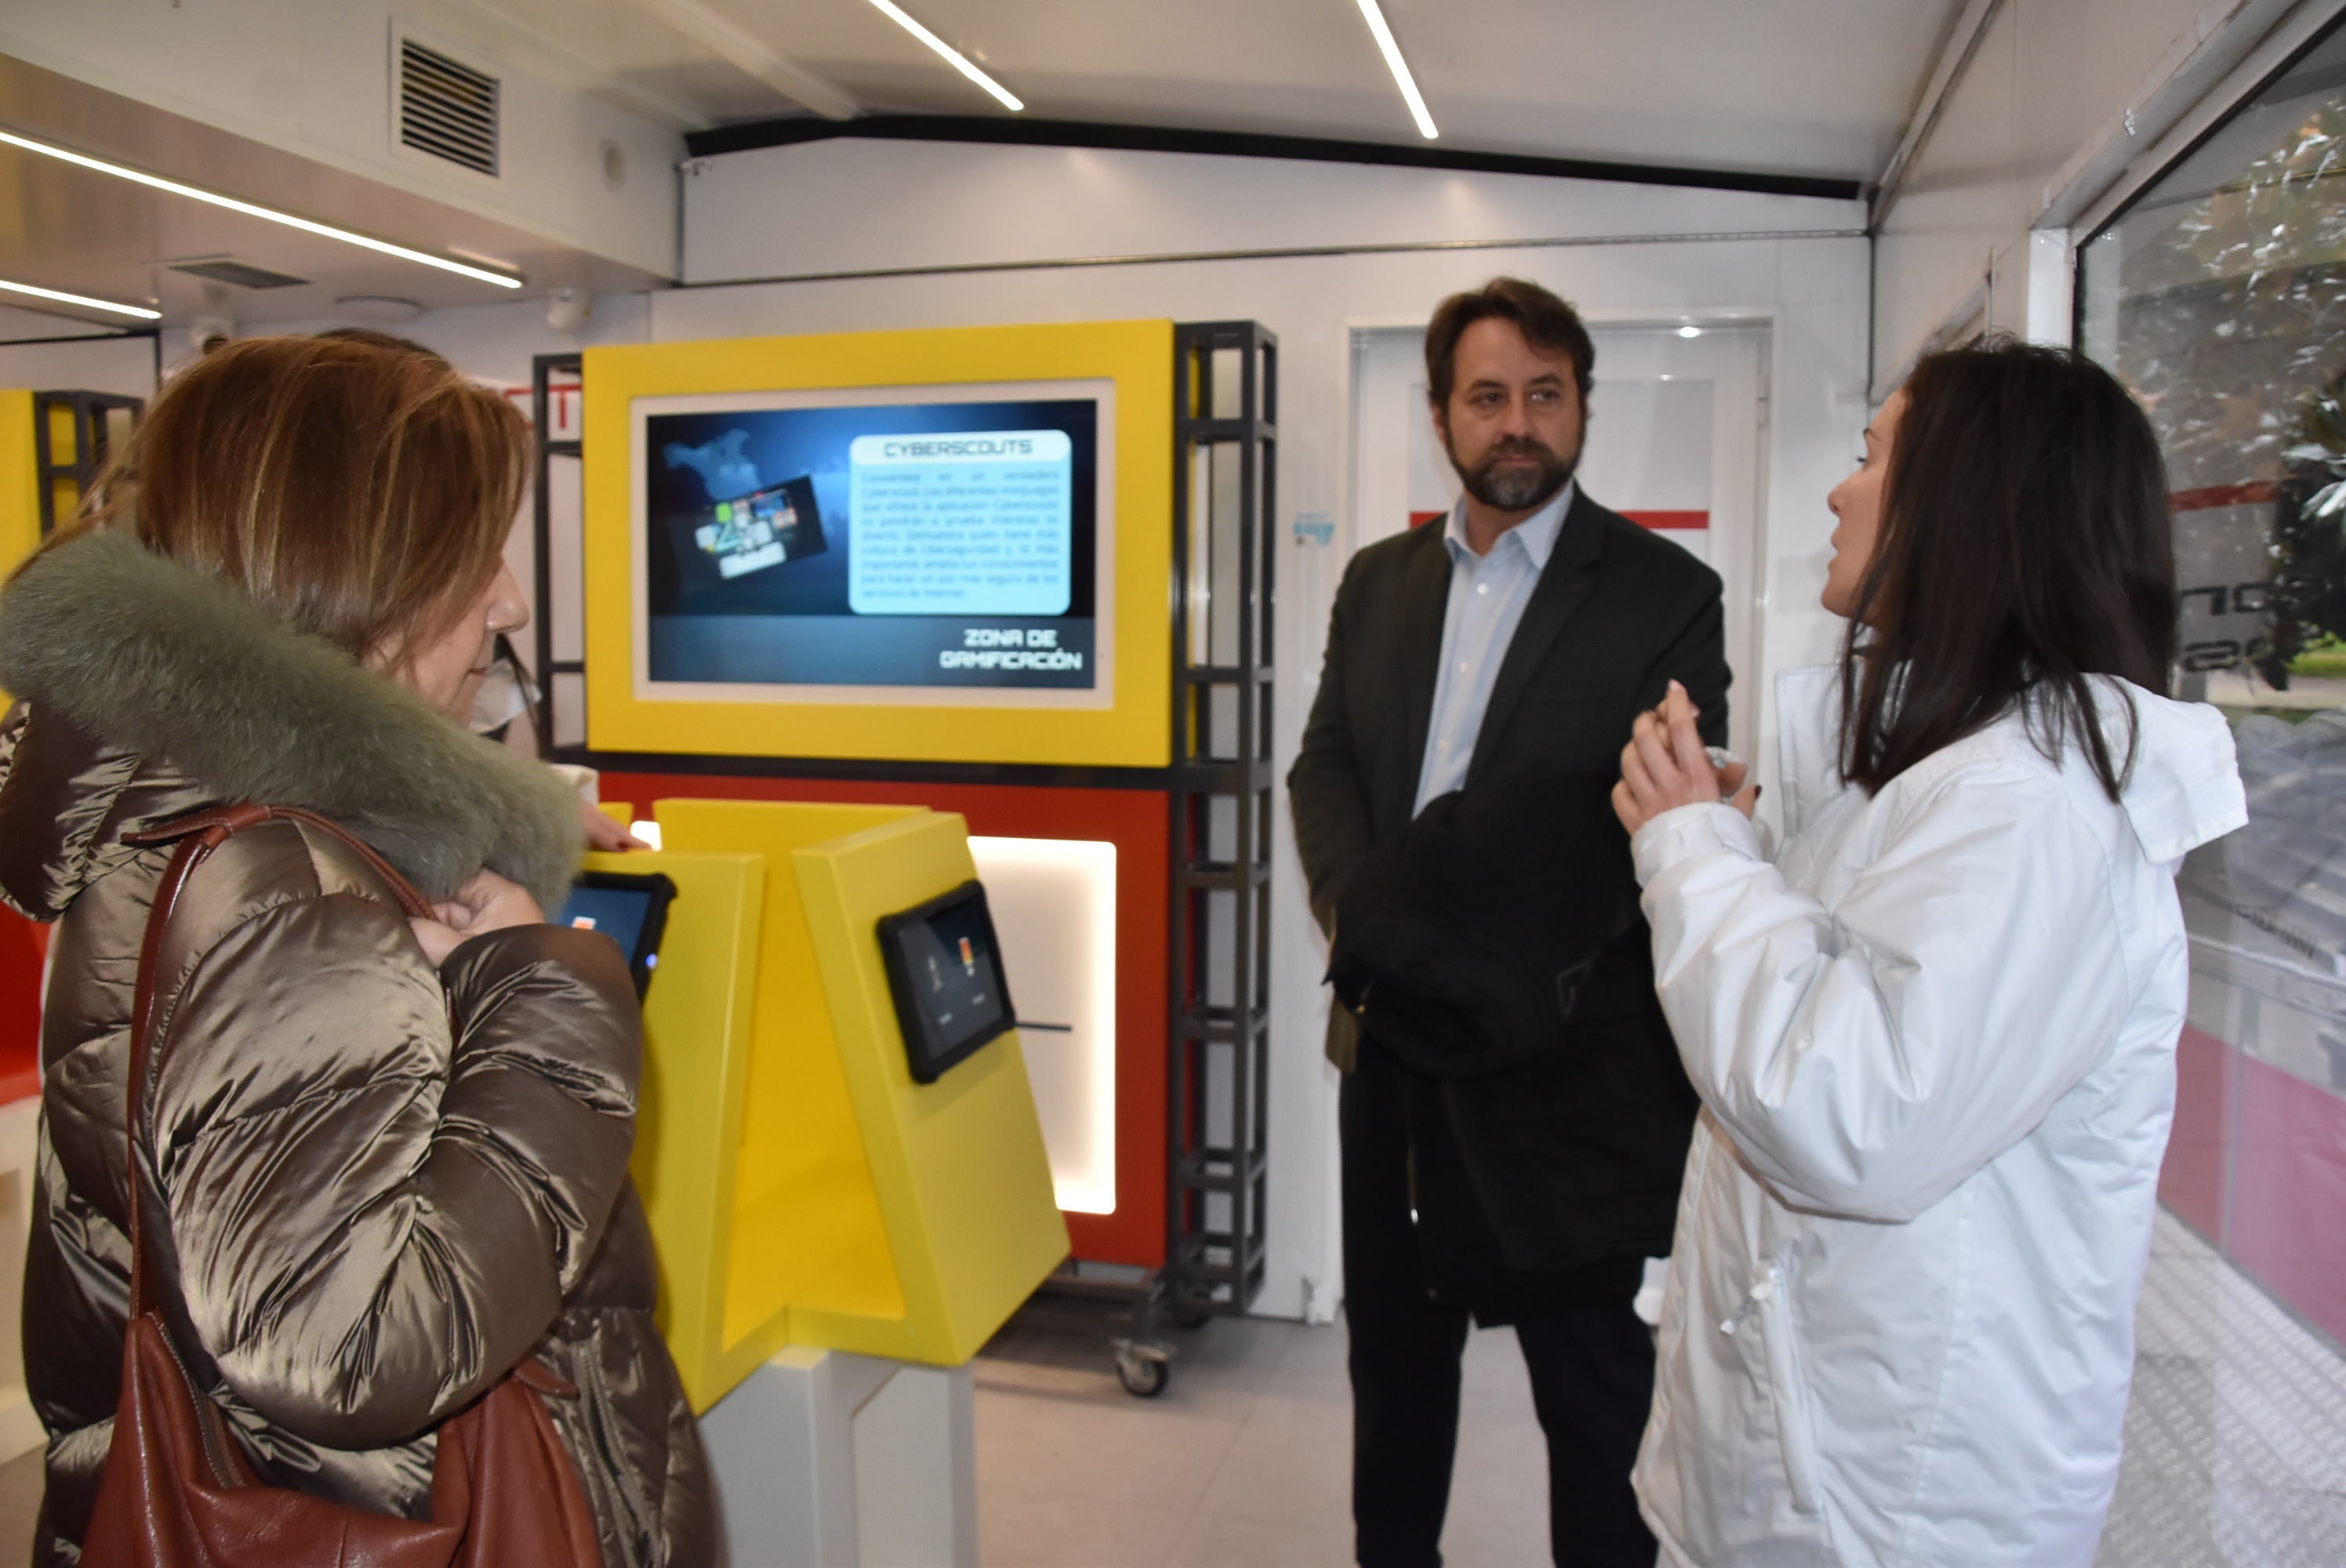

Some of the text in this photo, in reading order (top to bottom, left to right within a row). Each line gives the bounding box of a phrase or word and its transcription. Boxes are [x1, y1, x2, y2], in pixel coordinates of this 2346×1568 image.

[884, 438, 1033, 458] CYBERSCOUTS
[964, 628, 1058, 648] ZONA DE
[939, 648, 1083, 670] GAMIFICACIÓN
